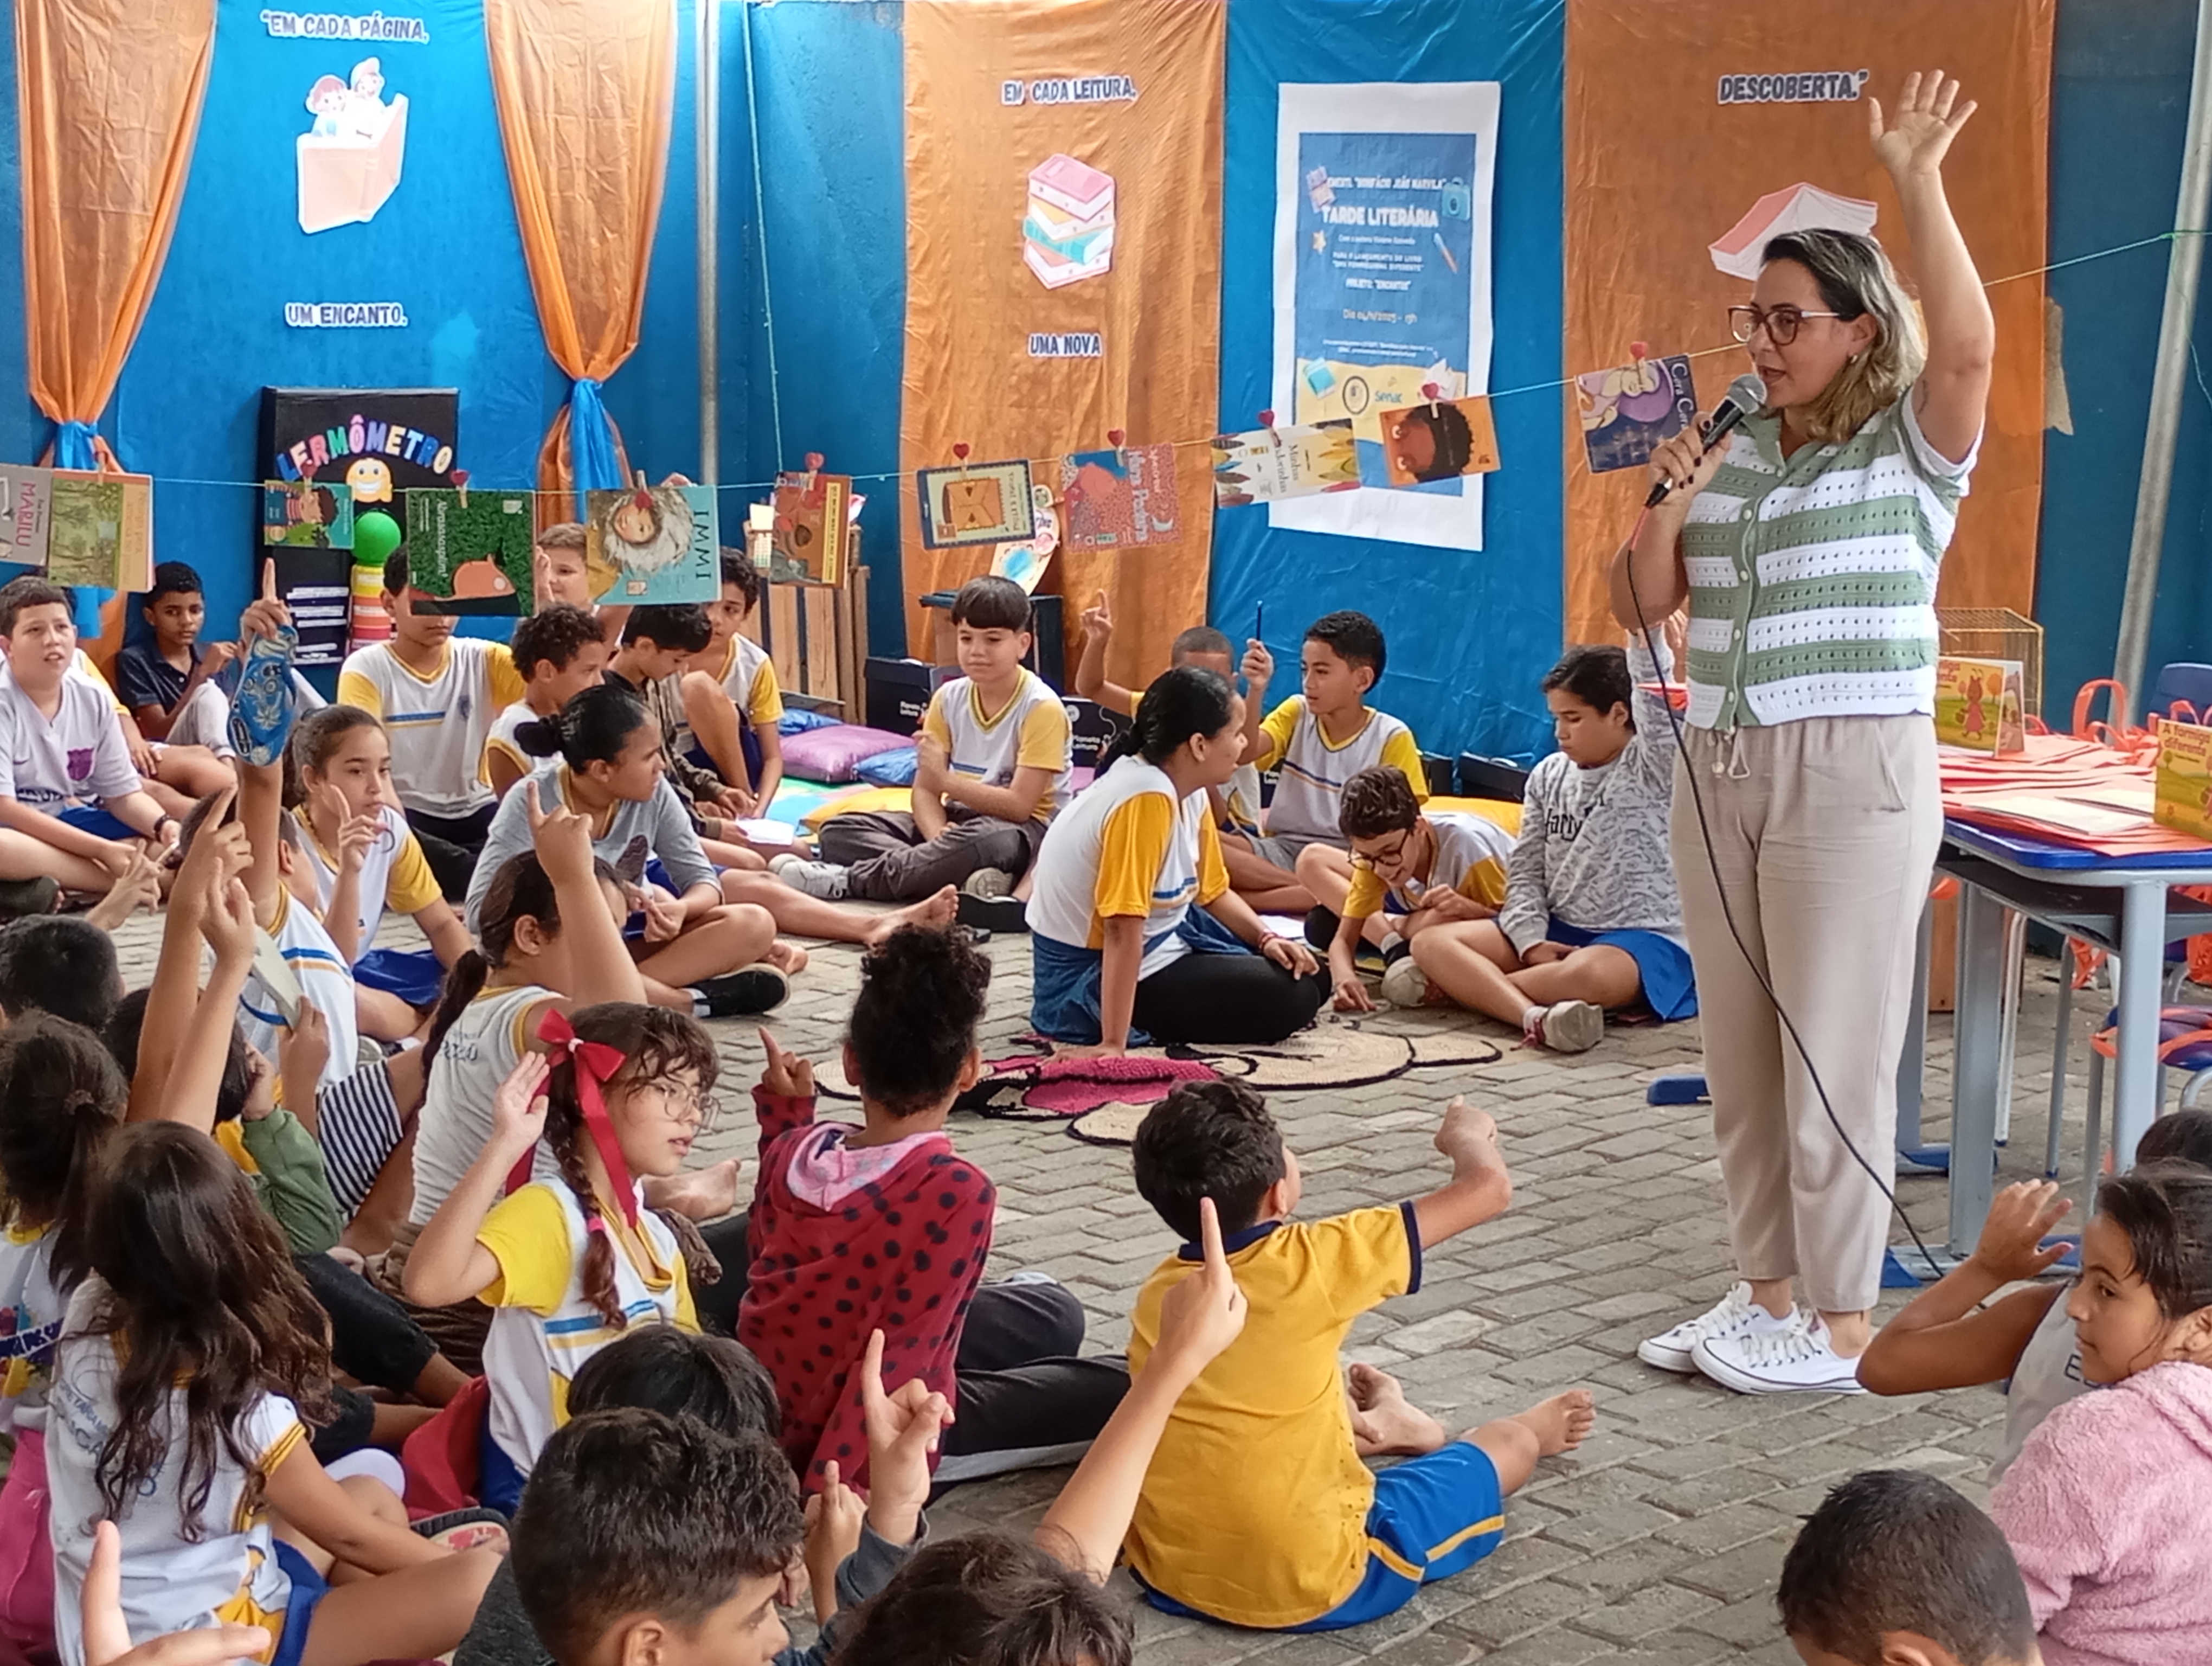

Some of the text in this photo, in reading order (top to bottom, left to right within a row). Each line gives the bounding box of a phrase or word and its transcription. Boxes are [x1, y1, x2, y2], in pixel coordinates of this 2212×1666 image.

[304, 17, 352, 36] CADA
[361, 12, 428, 41] PÁGINA,
[1004, 84, 1022, 102] EM
[1032, 81, 1069, 101] CADA
[1720, 72, 1868, 101] DESCOBERTA."
[1321, 204, 1439, 228] TARDE LITERÁRIA
[289, 306, 406, 324] UM ENCANTO.
[1031, 335, 1101, 355] UMA NOVA
[276, 414, 453, 482] LERMÔMETRO
[16, 482, 37, 547] MARILU
[693, 510, 711, 579] IMMI
[2163, 723, 2211, 745] A formiga
[2164, 736, 2207, 757] diferente
